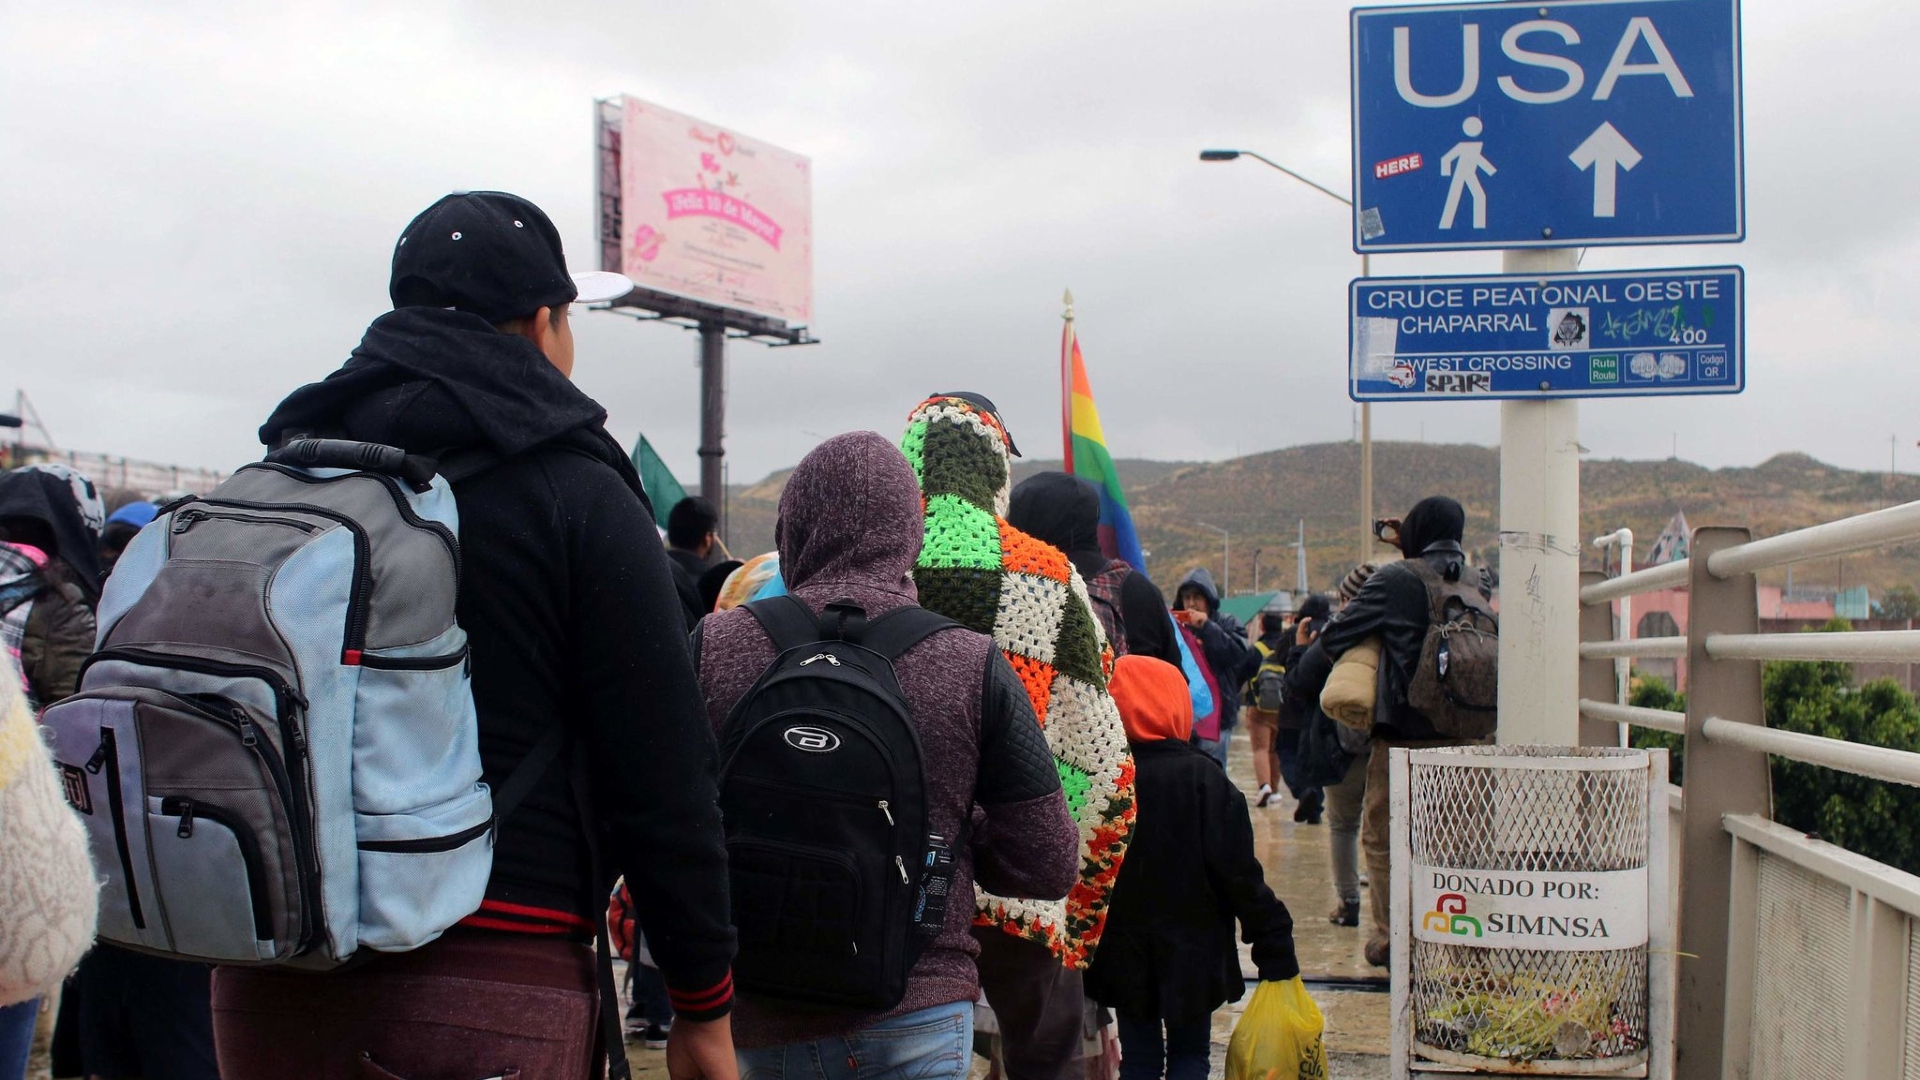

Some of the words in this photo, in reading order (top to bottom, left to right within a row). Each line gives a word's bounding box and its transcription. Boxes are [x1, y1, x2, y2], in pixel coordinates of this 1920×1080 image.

[1393, 16, 1694, 108] USA
[1376, 155, 1421, 178] HERE
[1368, 288, 1464, 310] CRUCE
[1473, 283, 1617, 307] PEATONAL
[1624, 279, 1720, 303] OESTE
[1401, 313, 1538, 334] CHAPARRAL
[1668, 328, 1708, 345] 400
[1468, 354, 1572, 371] CROSSING
[1592, 359, 1616, 369] Ruta
[1704, 367, 1719, 378] QR
[1592, 370, 1616, 380] Route
[1432, 872, 1535, 898] DONADO
[1541, 881, 1600, 900] POR:
[1487, 913, 1610, 938] SIMNSA
